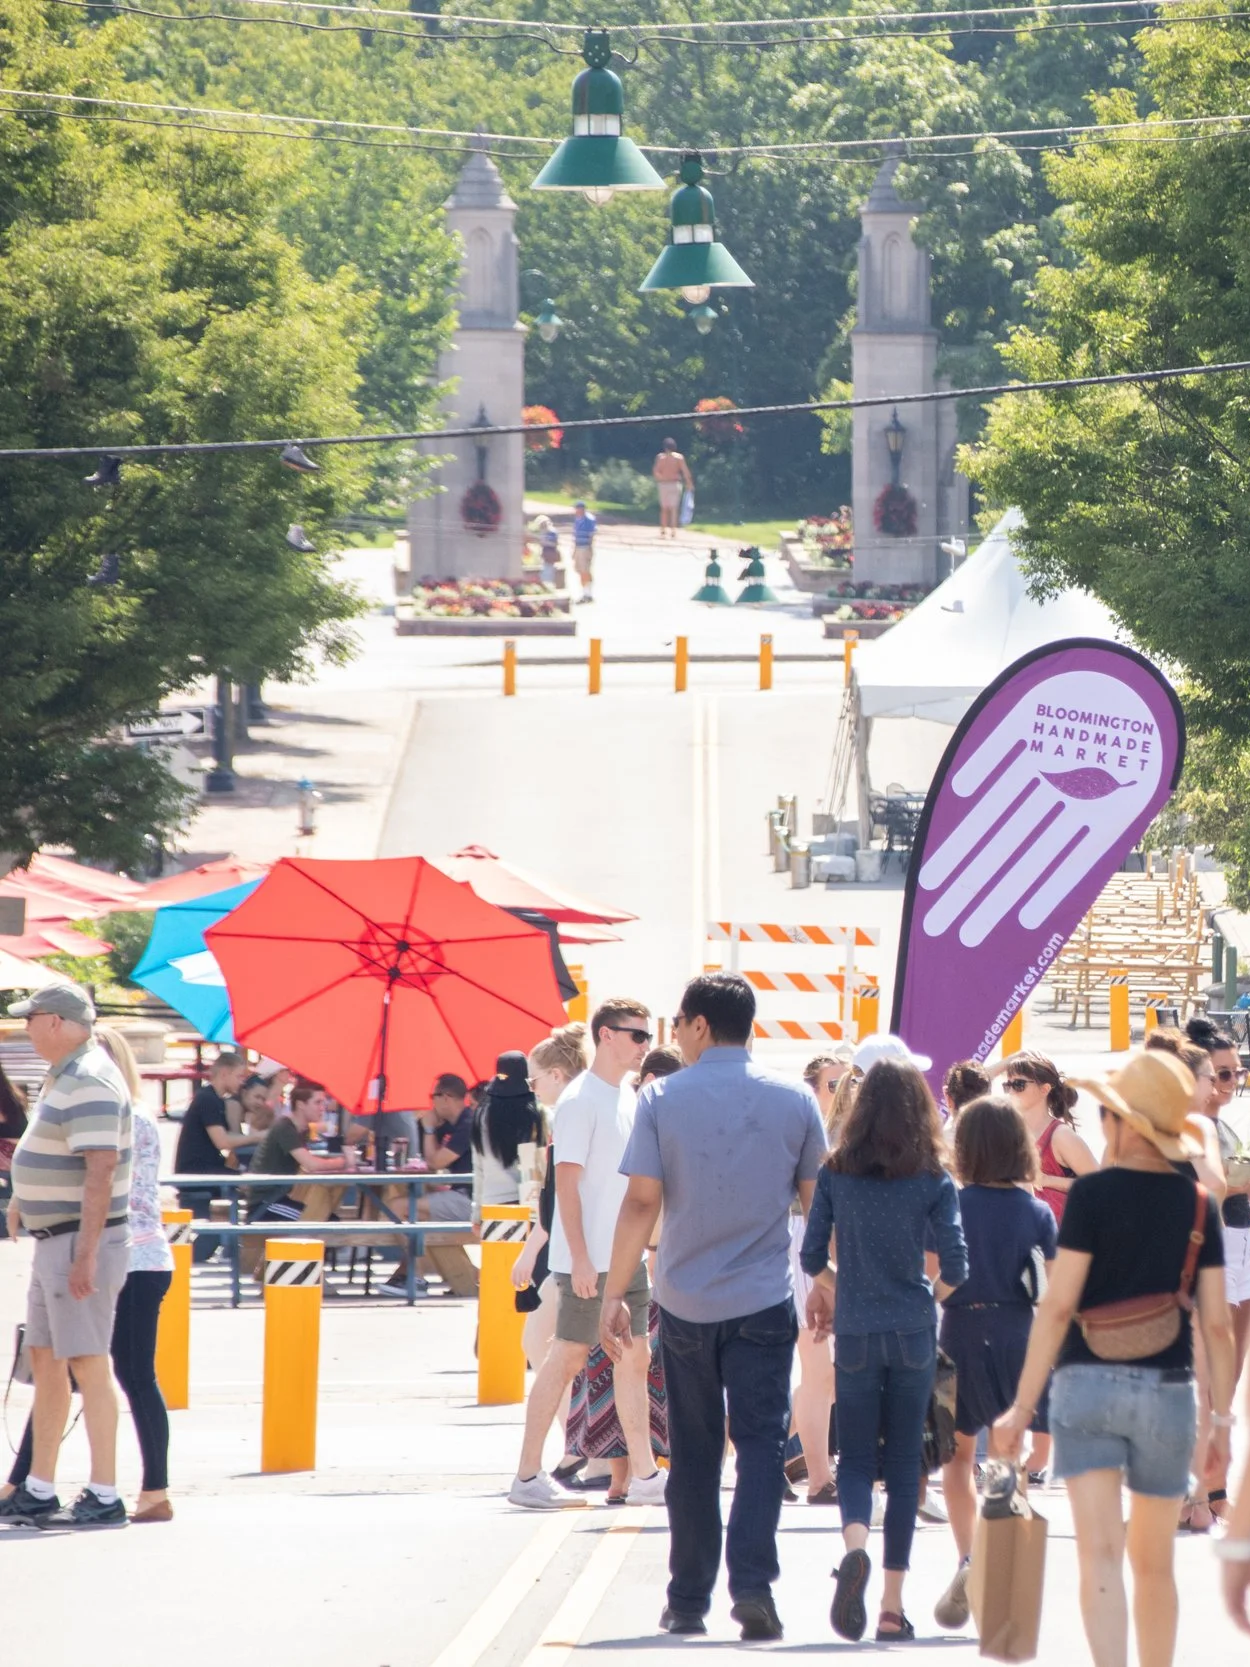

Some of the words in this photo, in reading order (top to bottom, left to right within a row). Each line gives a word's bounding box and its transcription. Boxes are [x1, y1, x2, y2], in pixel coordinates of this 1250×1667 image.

[1037, 704, 1154, 735] BLOOMINGTON
[1033, 722, 1151, 753] HANDMADE
[1030, 740, 1148, 771] MARKET
